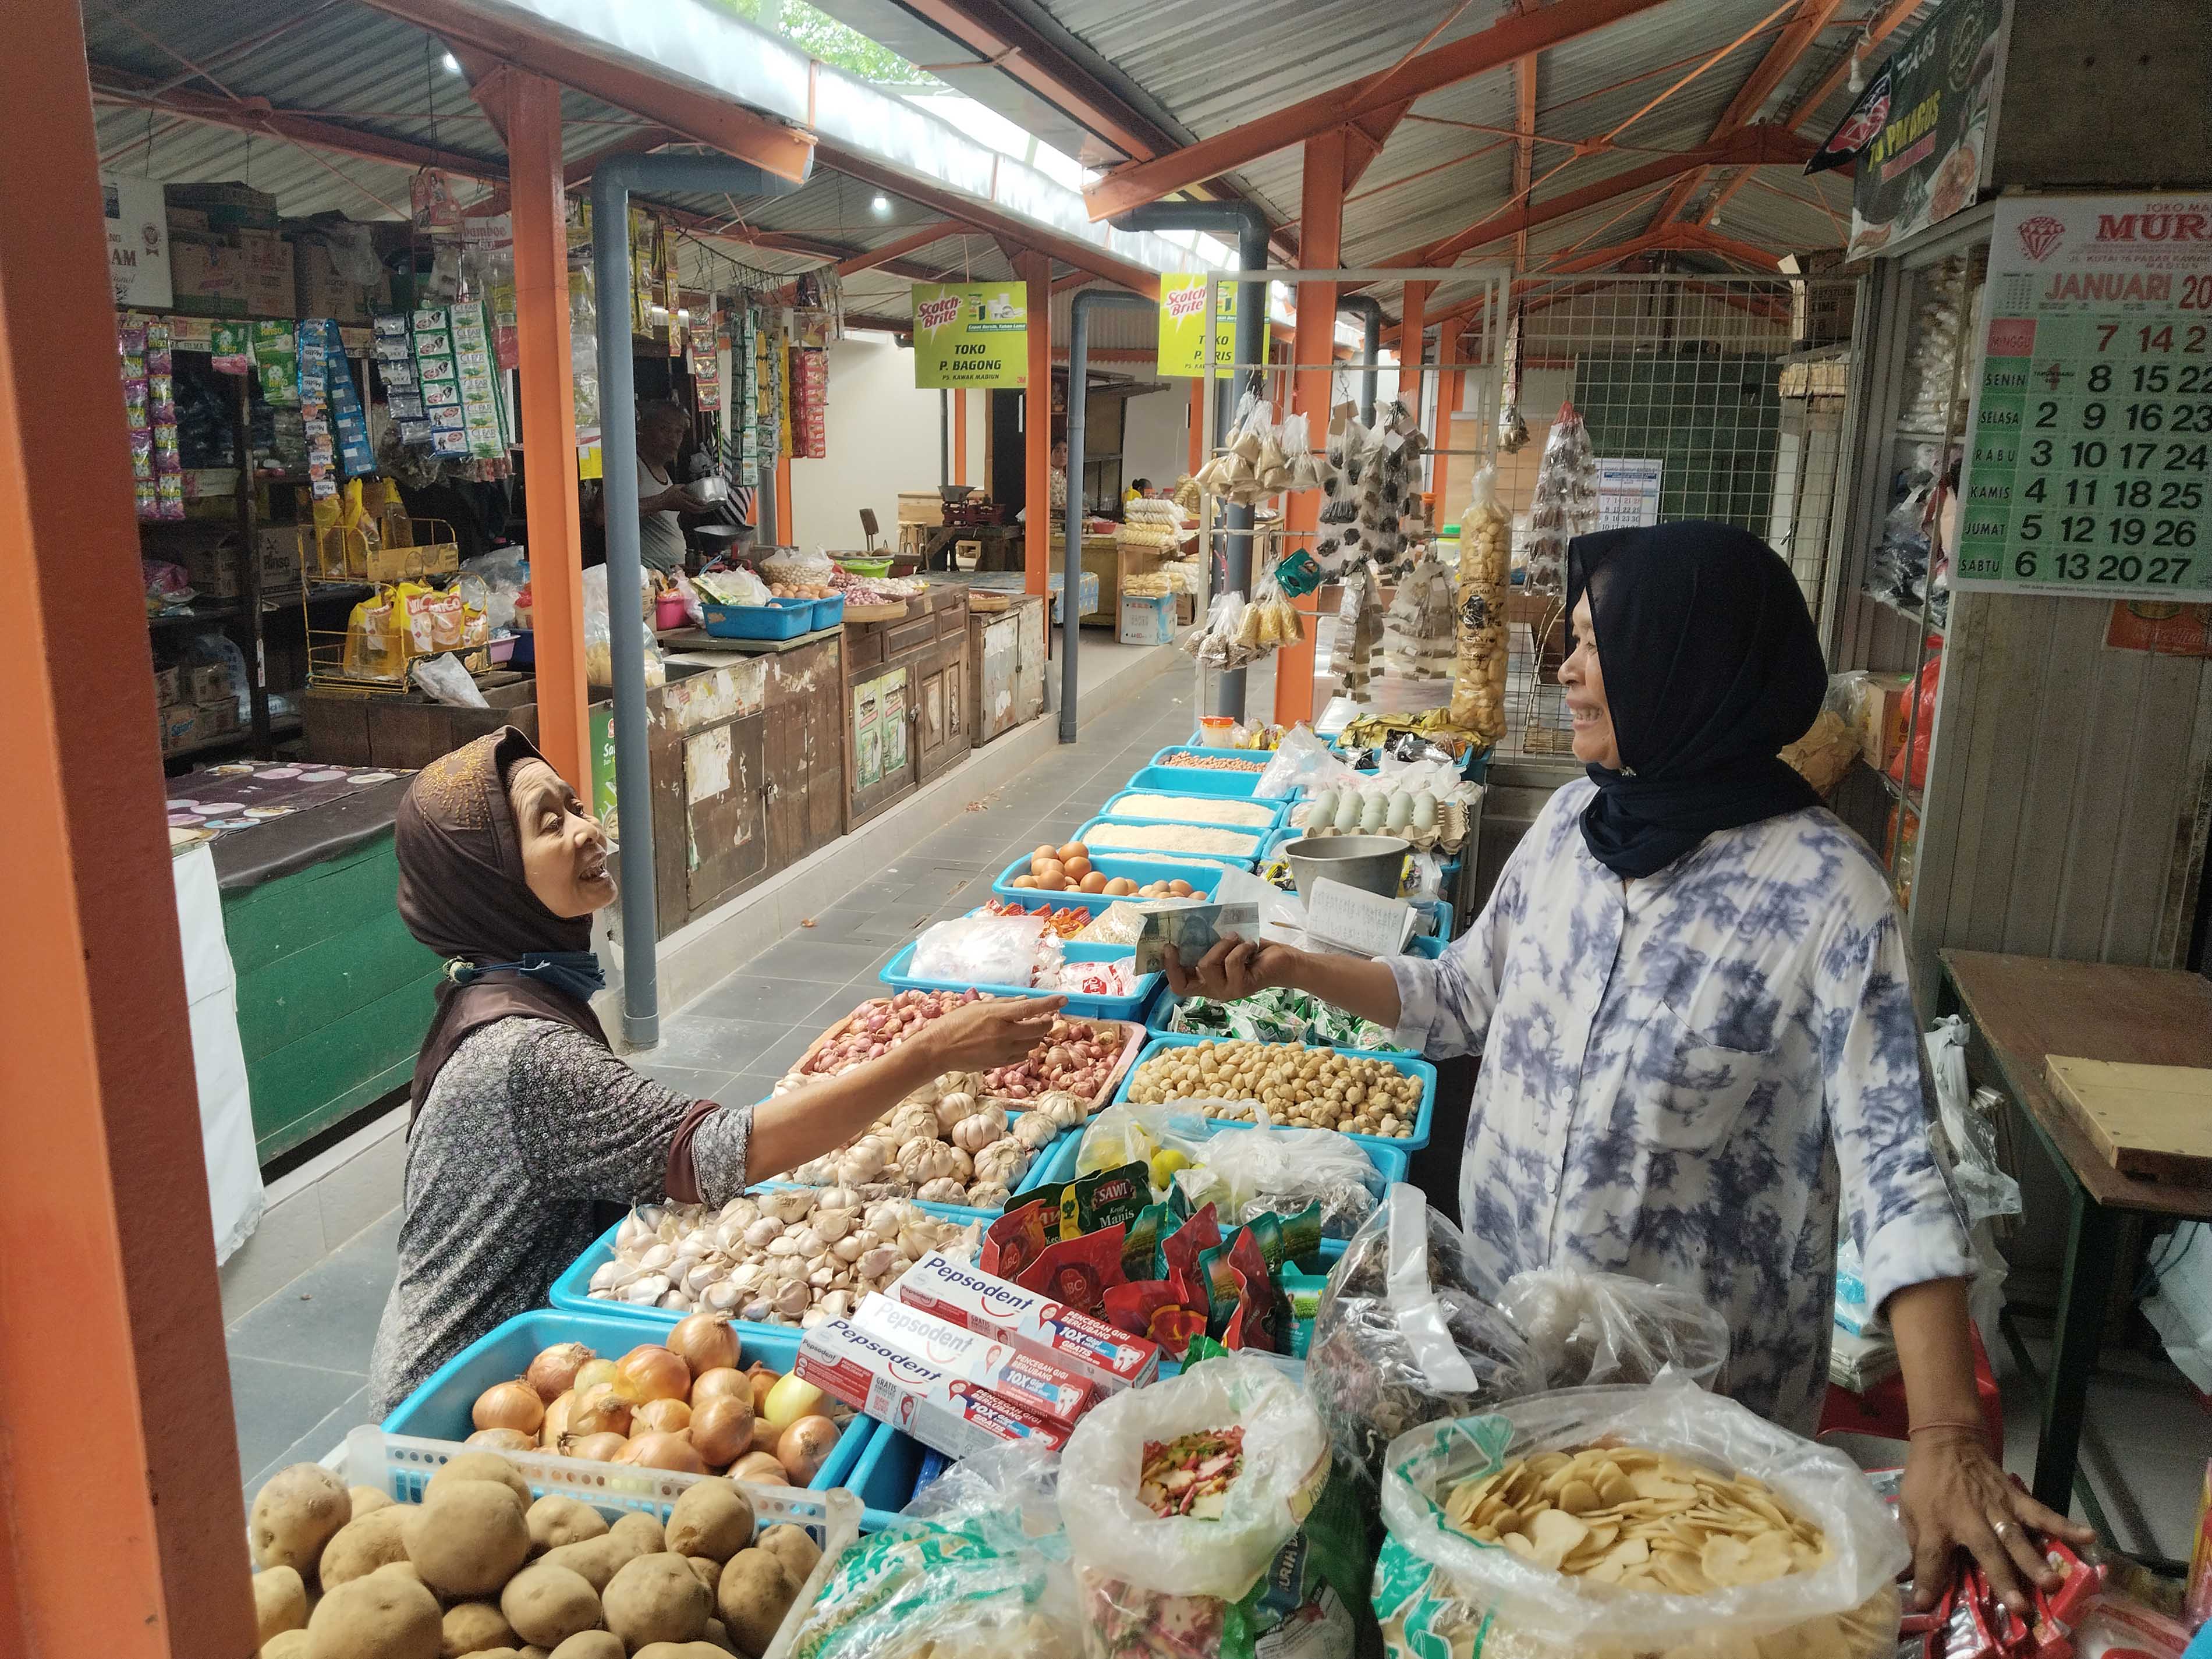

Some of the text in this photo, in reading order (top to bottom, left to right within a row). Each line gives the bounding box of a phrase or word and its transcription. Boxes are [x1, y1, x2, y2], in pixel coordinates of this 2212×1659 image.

[2145, 203, 2184, 212] TOKO
[2095, 214, 2212, 242] MUR
[112, 249, 136, 266] AM
[2044, 272, 2173, 302] JANUARI
[454, 304, 478, 313] CLEAR
[1171, 300, 1203, 316] Brite
[923, 309, 956, 328] Brite
[261, 327, 283, 336] Rinso
[456, 328, 481, 337] CLEAR
[1199, 335, 1229, 345] TKO
[1987, 335, 2032, 350] MINGGU
[2097, 325, 2120, 352] 7
[2139, 325, 2174, 353] 14
[460, 353, 484, 361] CLEAR
[955, 344, 986, 355] TOKO
[1194, 350, 1202, 360] P.
[940, 360, 1002, 371] P. BAGONG
[464, 379, 488, 387] CLEAR
[1984, 373, 2027, 387] SENIN
[2047, 363, 2061, 391] 1
[2087, 364, 2112, 393] 8
[2132, 365, 2170, 394] 15
[467, 403, 492, 412] CLEAR
[1979, 402, 2212, 433] SELASA 2 9 16 23
[472, 428, 496, 437] CLEAR
[1975, 439, 2208, 472] RABU 3 10 17 24
[1970, 477, 2204, 509] KAMIS 4 11 18 25
[1965, 515, 2197, 548] JUMAT 5 12 19 26
[263, 556, 290, 569] Rinso
[1961, 550, 2192, 584] SABTU 6 13 20 27
[1099, 1182, 1128, 1202] SAWI
[1099, 1207, 1135, 1228] Manis
[923, 1256, 1034, 1311] Pepsodent
[874, 1301, 974, 1353] Pepsodent
[1059, 1326, 1087, 1343] 10X
[1061, 1316, 1111, 1340] BERLUBANG
[1066, 1310, 1131, 1341] PENCEGAH GIGI
[802, 1338, 836, 1360] Pepsodent
[826, 1320, 943, 1381] Pepsodent
[1061, 1339, 1093, 1357] GRATIS
[1011, 1360, 1053, 1381] BERLUBANG
[1016, 1354, 1069, 1380] PENCEGAH GIGI
[876, 1377, 897, 1392] GRATIS
[1006, 1370, 1031, 1388] 10X
[970, 1392, 1023, 1421] BERLUBANG
[970, 1402, 998, 1419] 10X
[976, 1389, 1023, 1415] PENCEGAH
[1023, 1412, 1042, 1424] GIGI
[973, 1413, 1006, 1433] GRATIS
